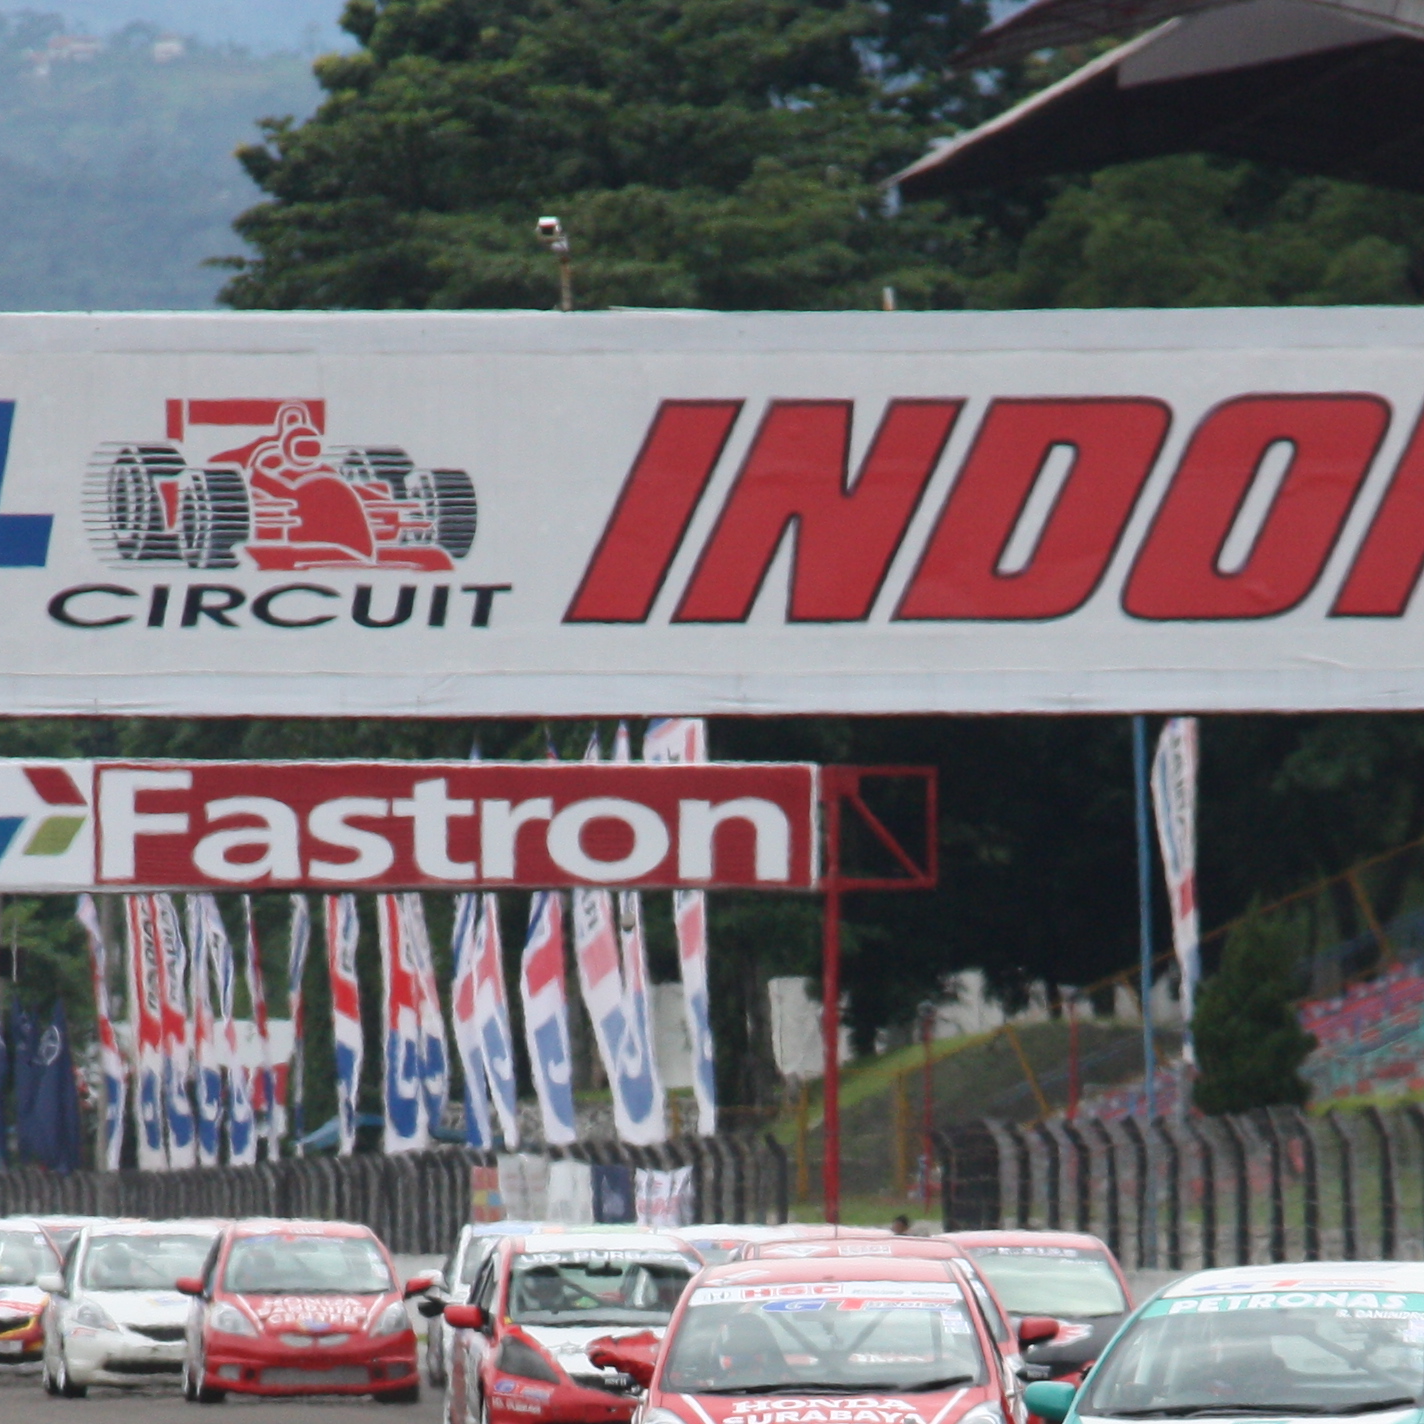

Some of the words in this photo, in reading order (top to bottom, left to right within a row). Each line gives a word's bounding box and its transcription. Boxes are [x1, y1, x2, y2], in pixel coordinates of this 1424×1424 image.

[48, 583, 513, 628] CIRCUIT
[99, 769, 790, 882] Fastron
[1168, 1291, 1407, 1315] PETRONAS
[732, 1397, 917, 1414] HONDA
